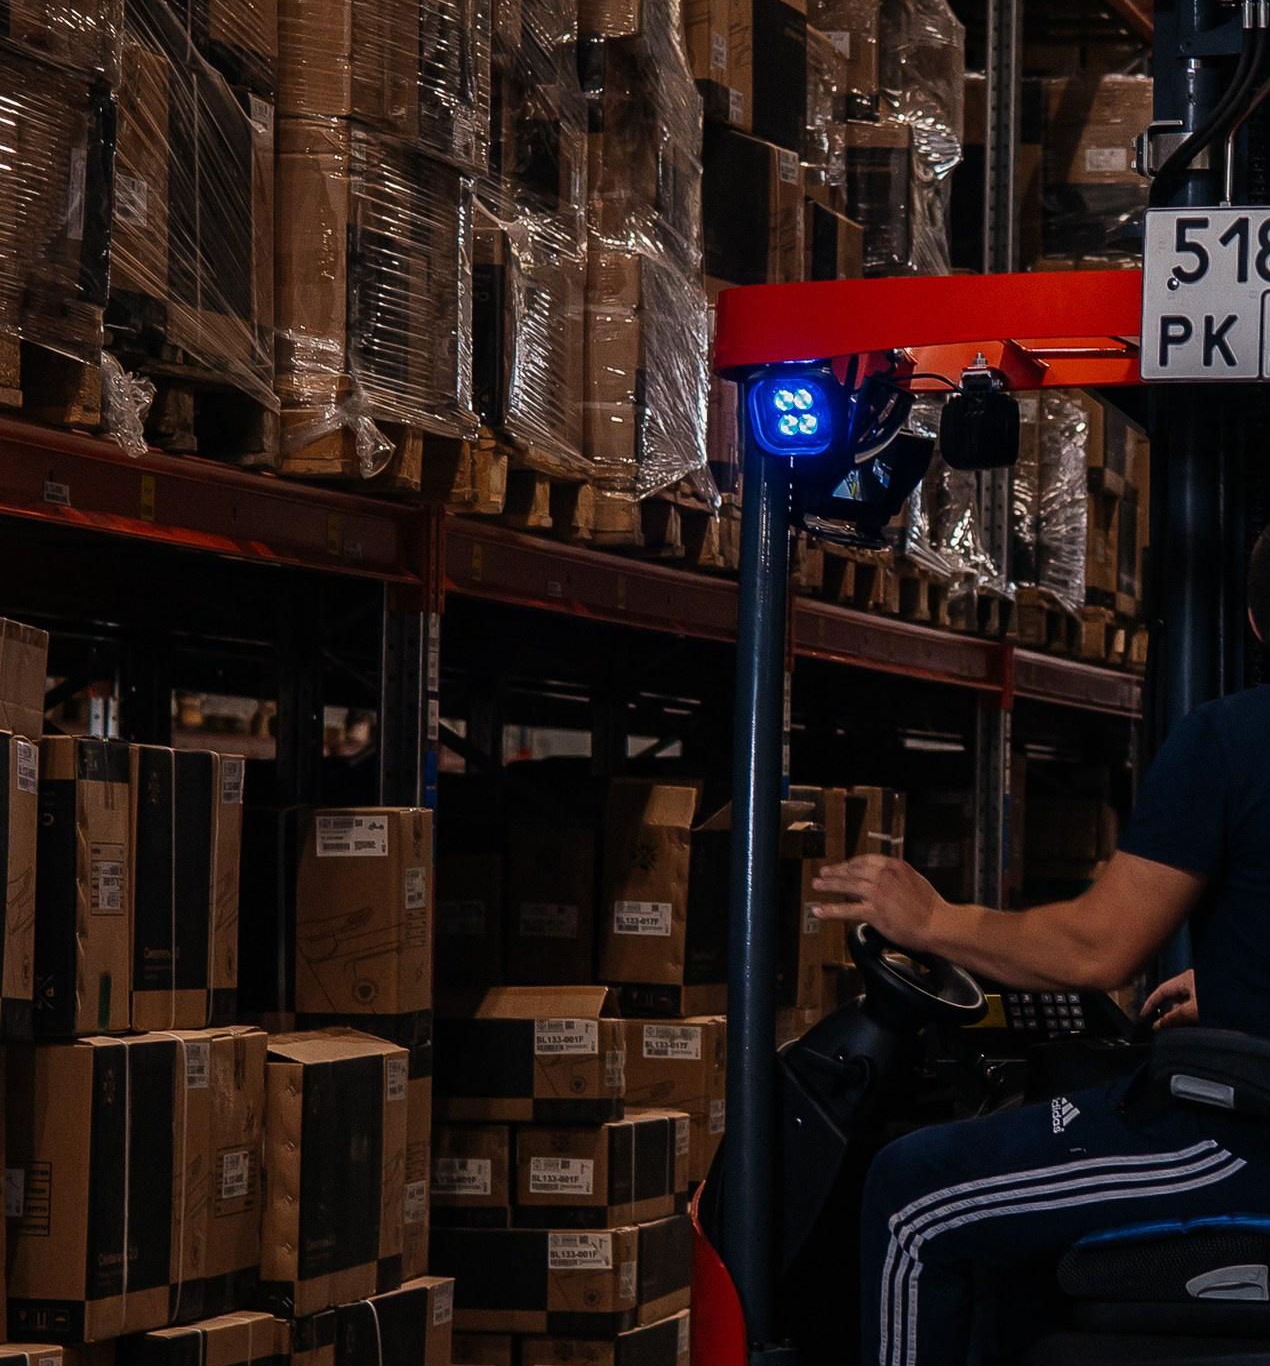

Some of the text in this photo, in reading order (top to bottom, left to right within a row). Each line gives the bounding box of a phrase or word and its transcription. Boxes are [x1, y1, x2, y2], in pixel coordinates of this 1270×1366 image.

[1158, 314, 1239, 368] PK
[536, 1035, 584, 1044] SL133-001F
[531, 1174, 579, 1183] SL133-001F
[550, 1249, 598, 1259] SL133-001F
